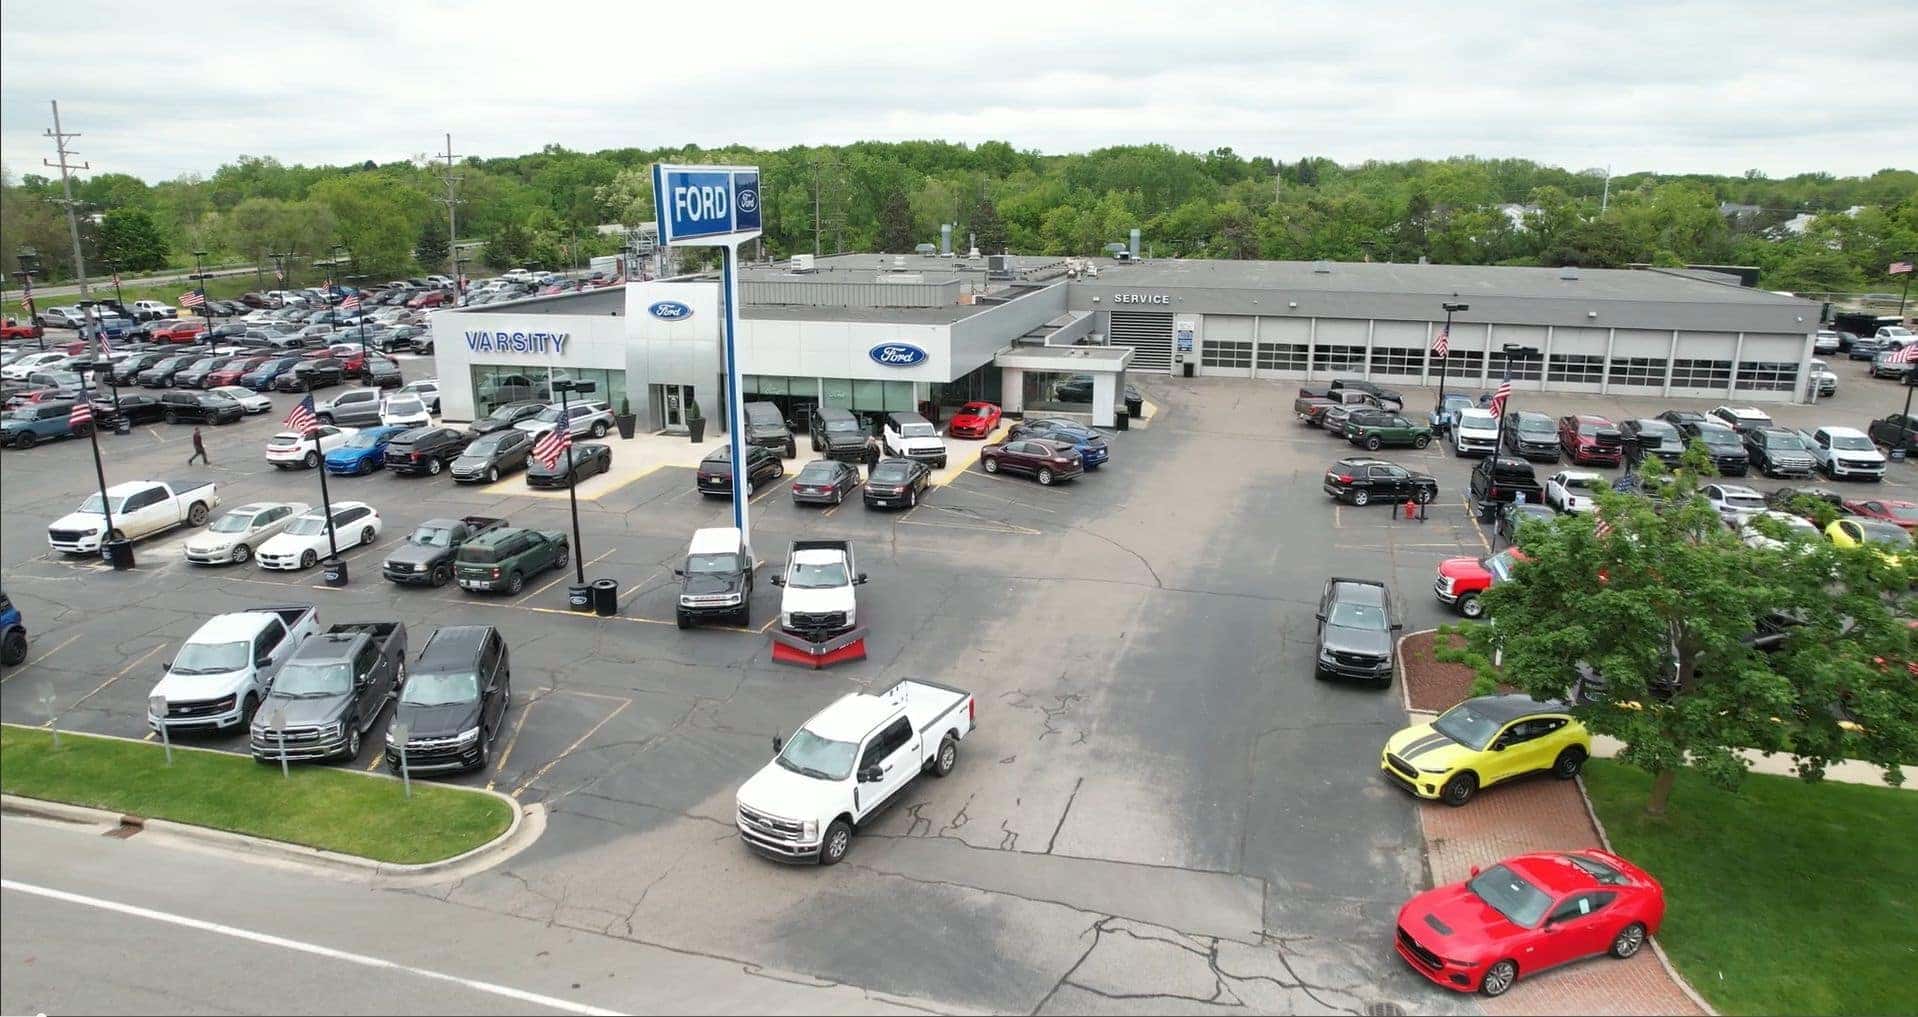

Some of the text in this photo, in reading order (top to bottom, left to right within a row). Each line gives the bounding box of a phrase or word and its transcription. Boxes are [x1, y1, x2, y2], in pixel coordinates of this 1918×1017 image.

[674, 186, 727, 222] FORD
[1114, 294, 1169, 304] SERVICE
[656, 304, 682, 316] Ford
[465, 331, 563, 353] VARSITY
[880, 346, 914, 362] Ford
